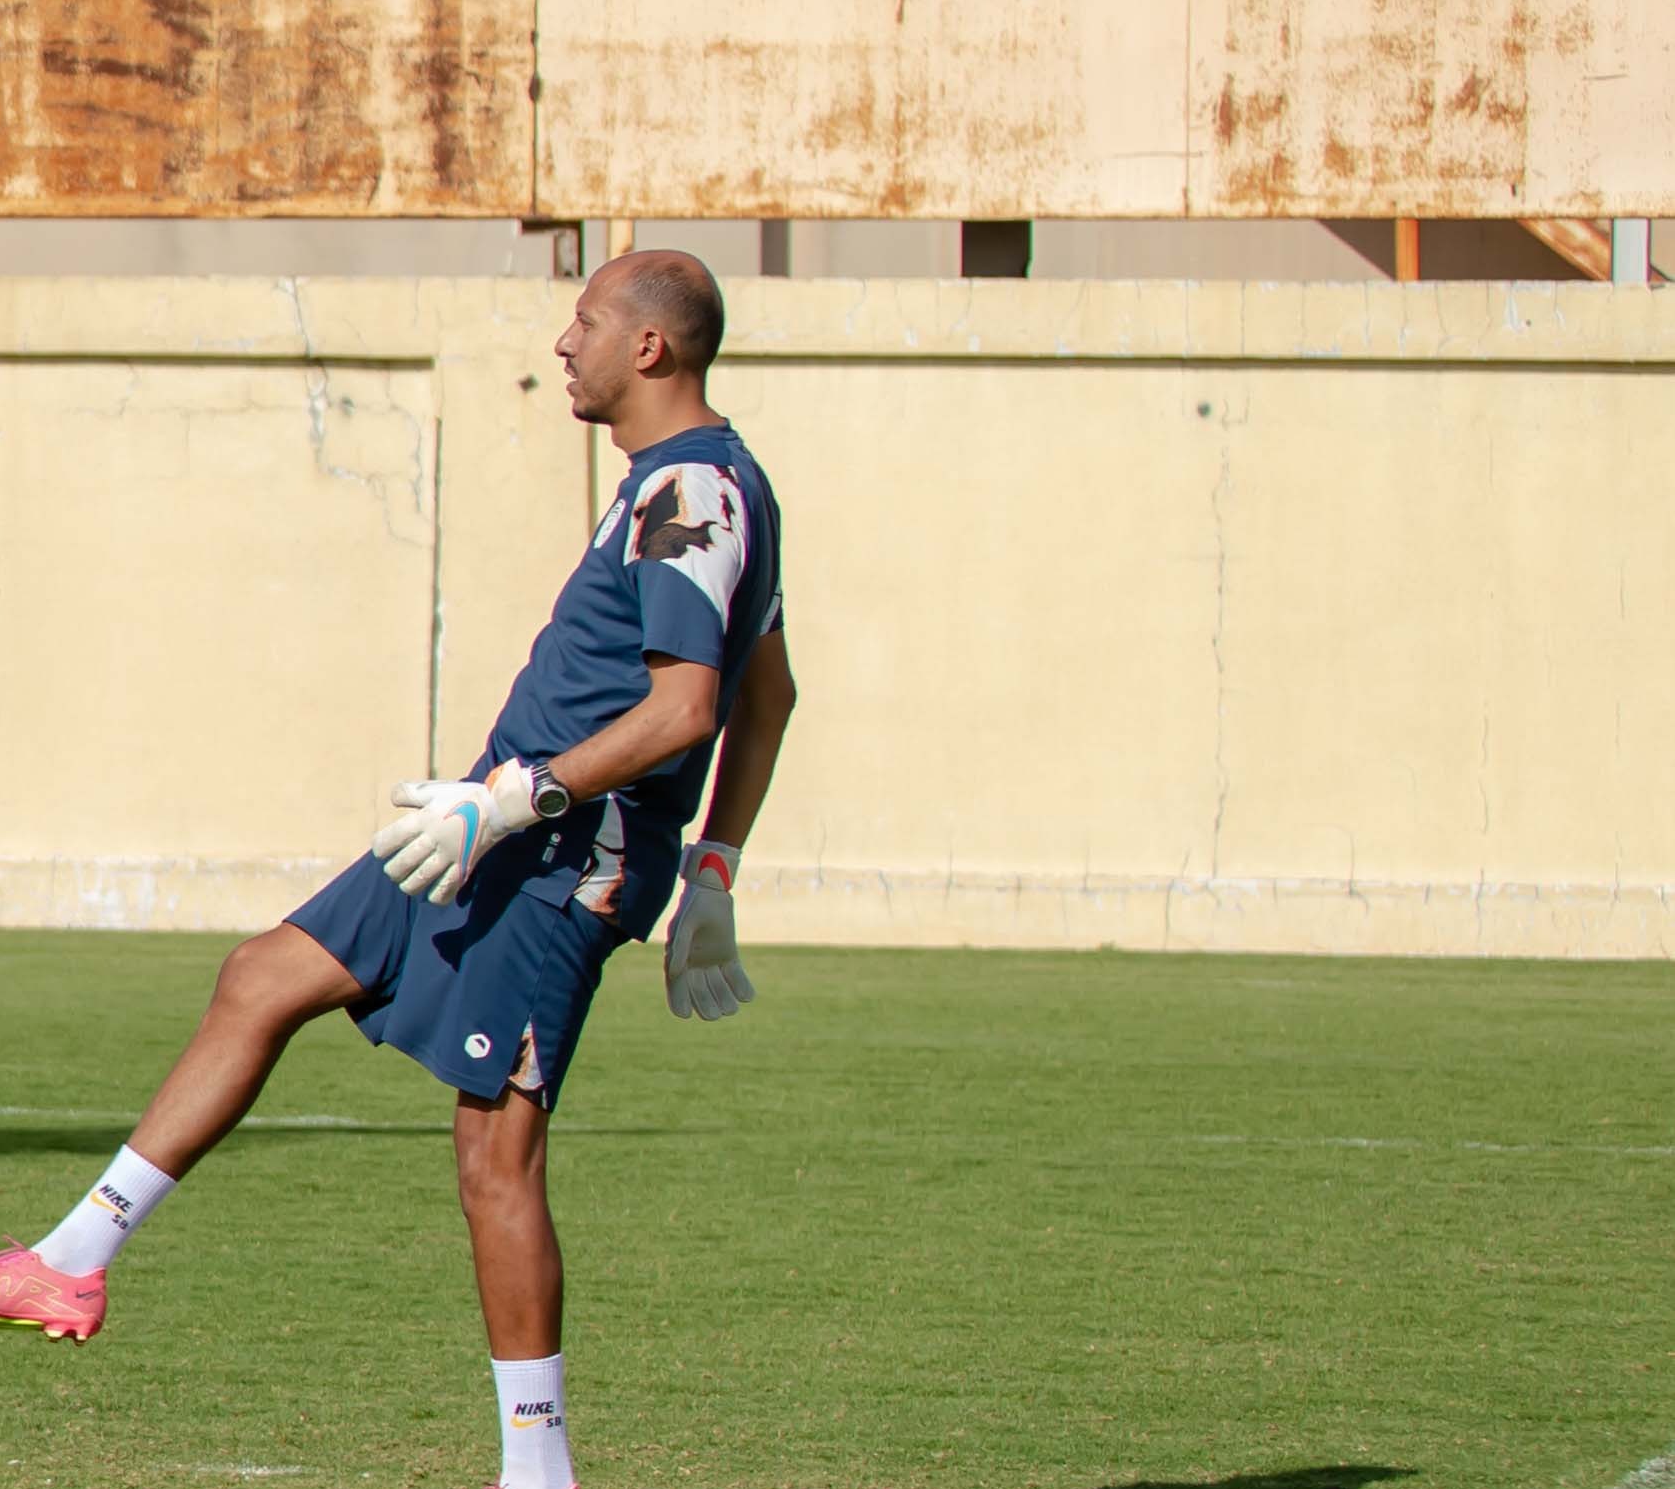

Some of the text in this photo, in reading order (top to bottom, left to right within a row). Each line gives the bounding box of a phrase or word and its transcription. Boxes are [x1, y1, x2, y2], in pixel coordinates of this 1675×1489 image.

[99, 1183, 134, 1213] NIKE
[111, 1214, 128, 1230] SB
[514, 1400, 555, 1415] NIKE
[545, 1416, 562, 1428] SB
